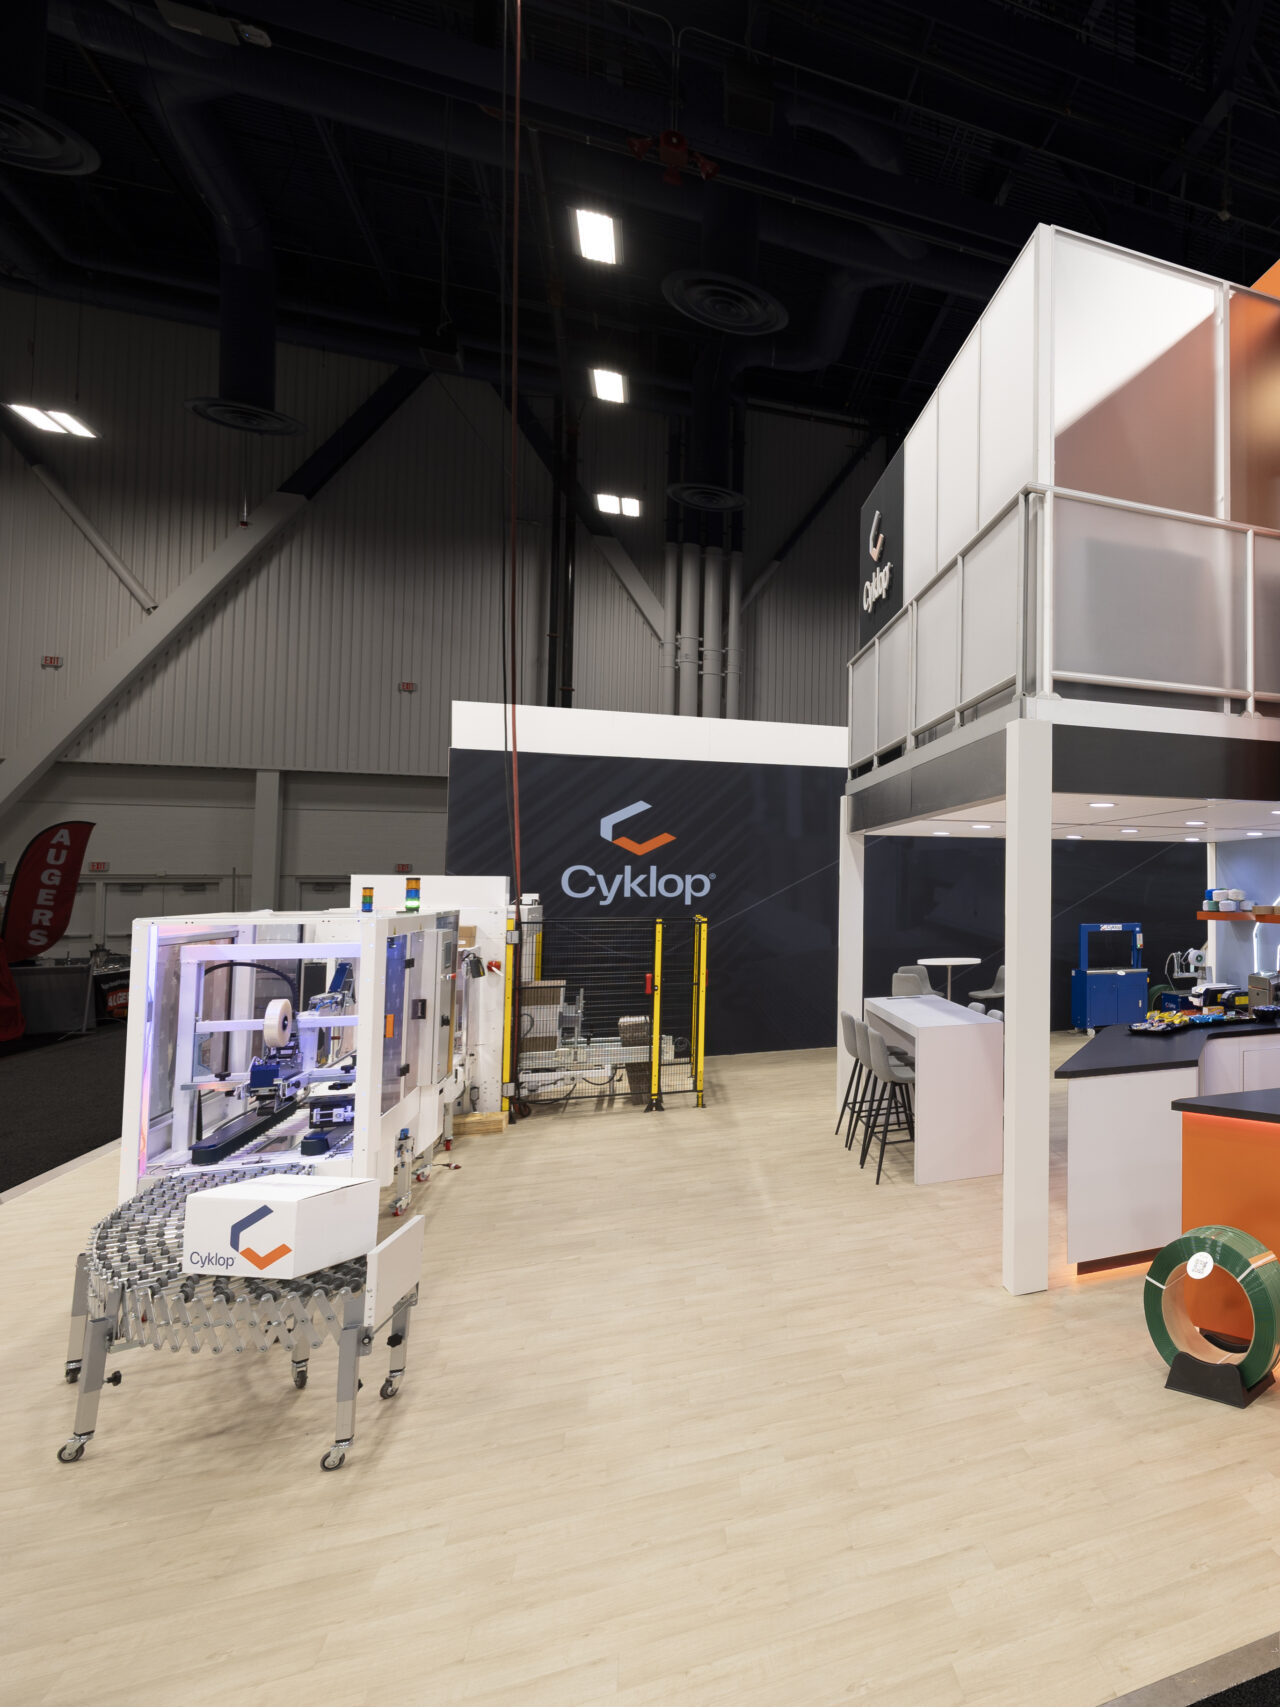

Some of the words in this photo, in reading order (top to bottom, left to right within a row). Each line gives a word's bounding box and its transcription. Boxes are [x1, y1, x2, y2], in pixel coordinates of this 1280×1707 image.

[44, 655, 60, 665] EXIT
[28, 828, 72, 946] AUGERS
[189, 1251, 235, 1269] Cyklop
